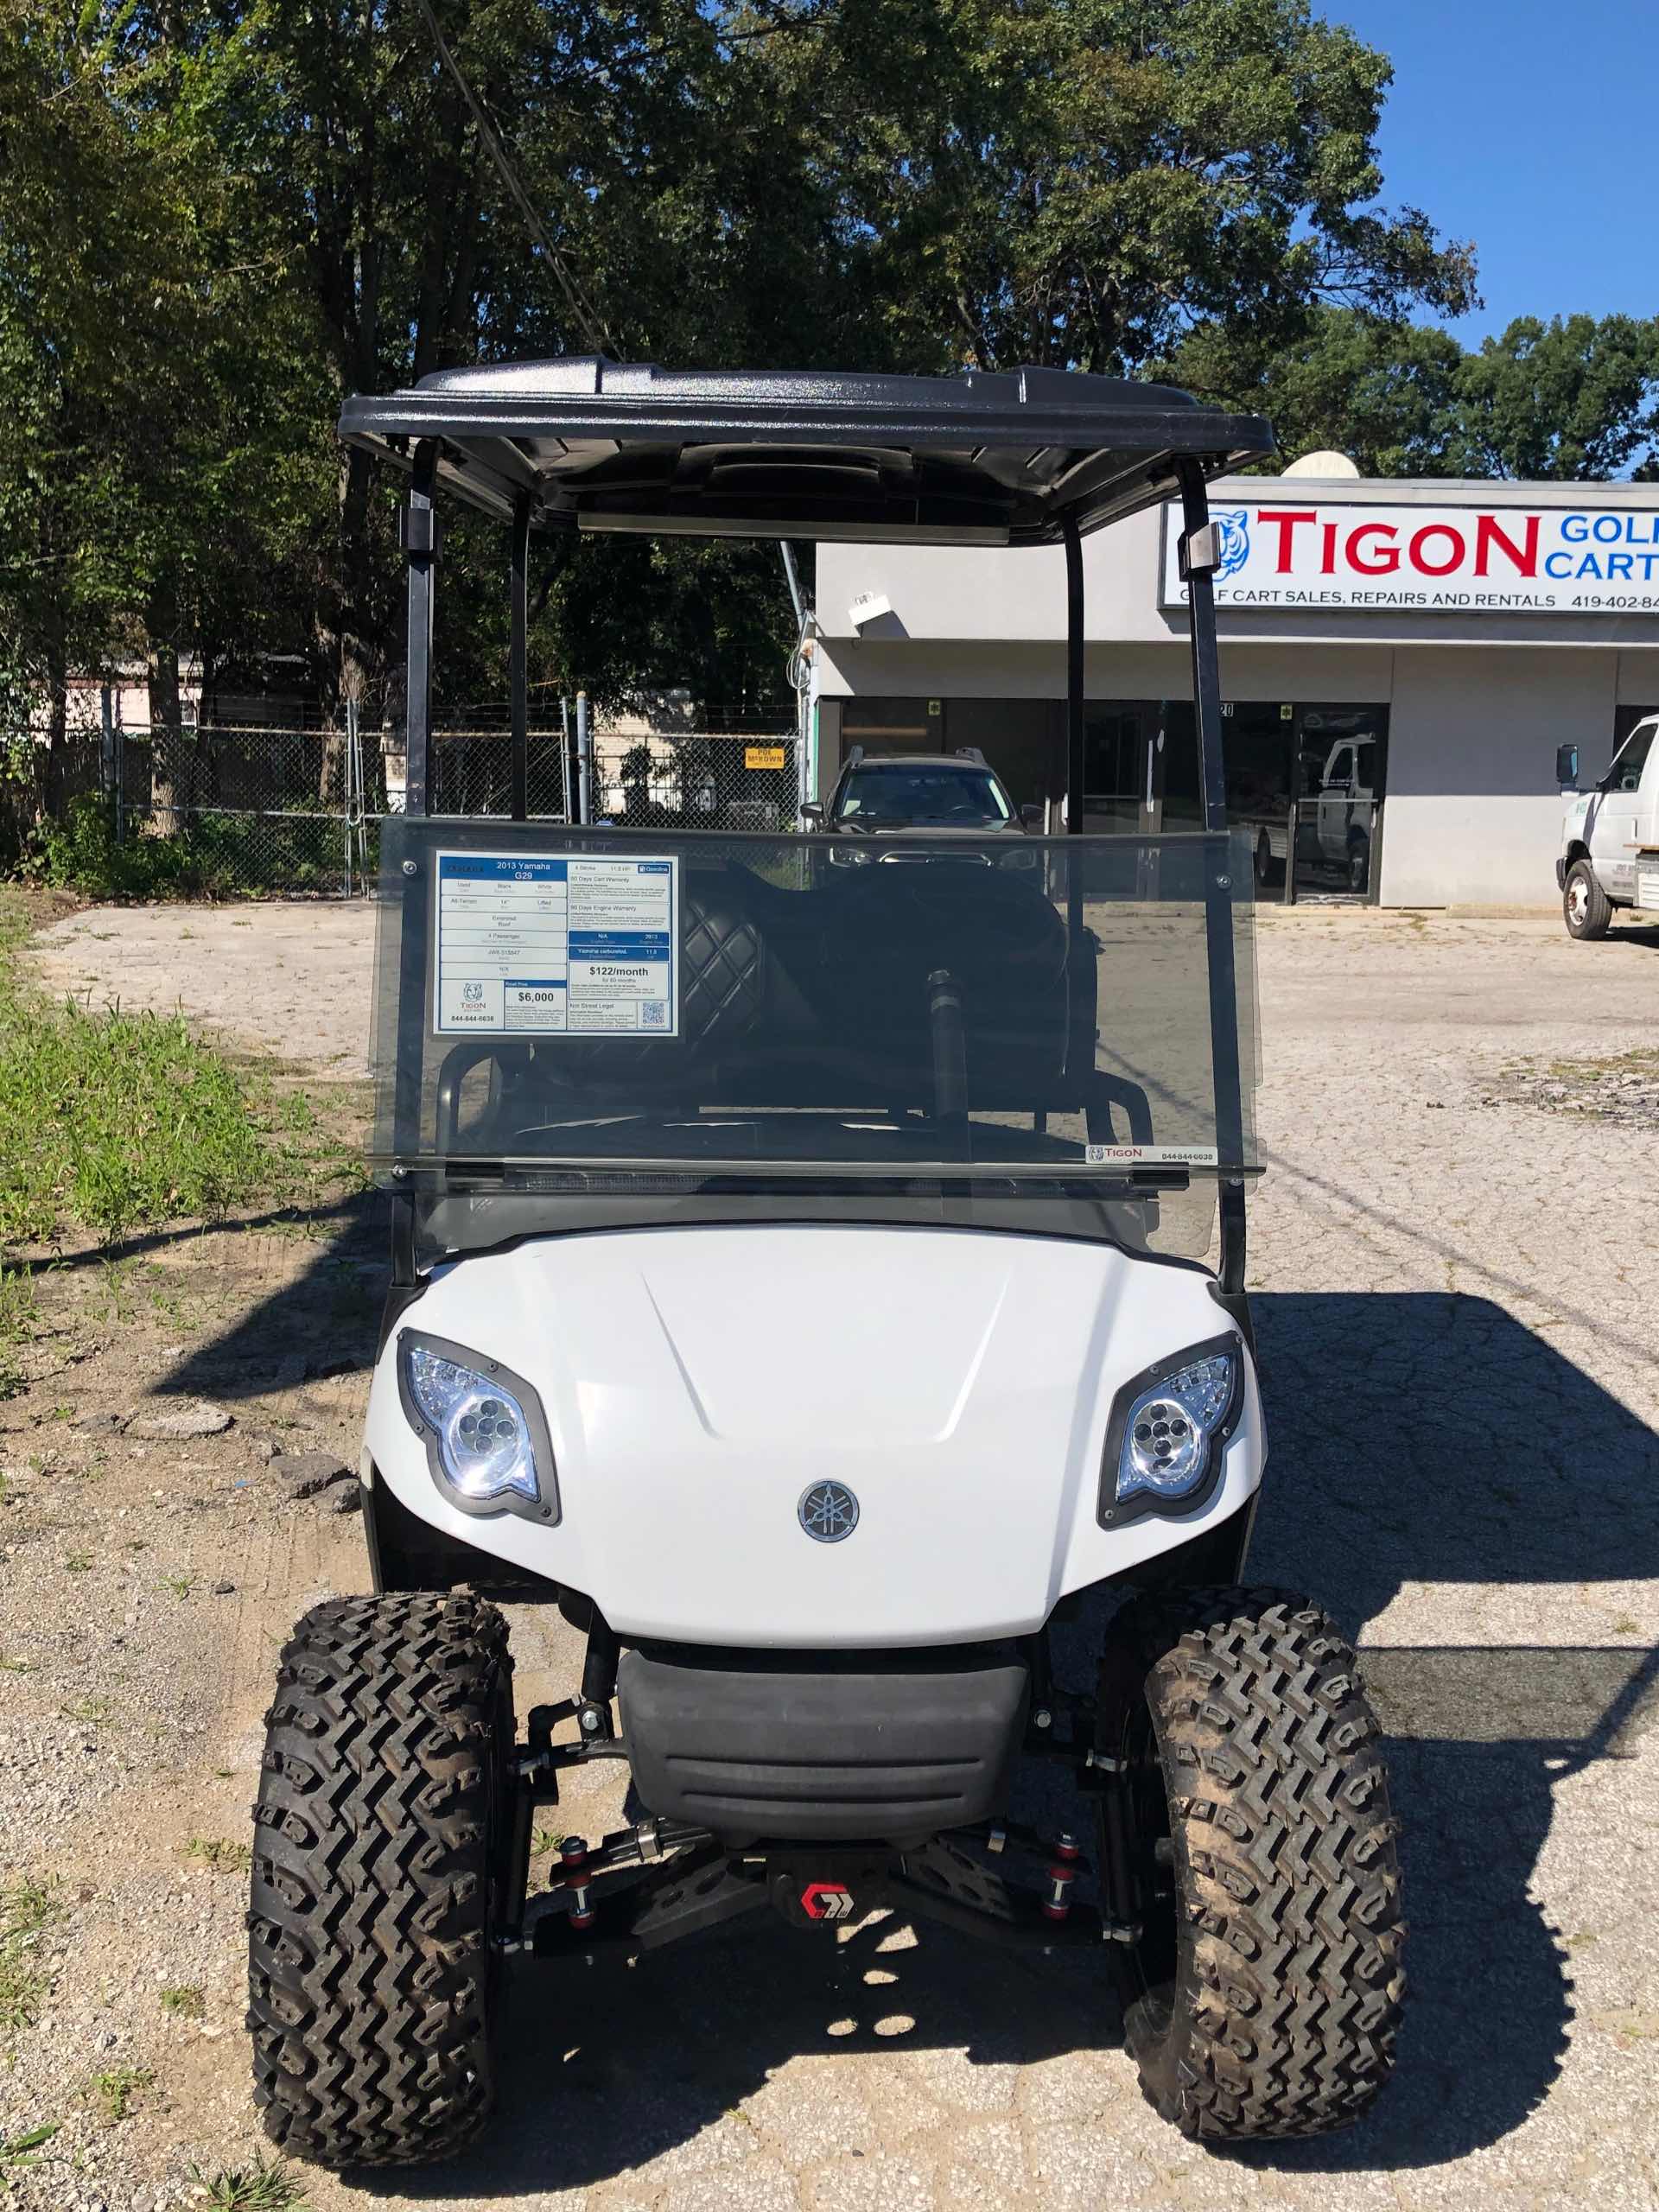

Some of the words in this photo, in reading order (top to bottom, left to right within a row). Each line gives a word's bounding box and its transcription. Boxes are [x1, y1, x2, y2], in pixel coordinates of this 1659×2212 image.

[1560, 515, 1659, 543] GOL
[1257, 509, 1541, 577] TIGON
[1180, 590, 1230, 602] GF
[1233, 590, 1281, 602] CART
[1286, 591, 1346, 604] SALES,
[1351, 592, 1427, 604] REPAIRS
[1432, 594, 1470, 605] AND
[1475, 594, 1555, 607] RENTALS
[497, 861, 517, 870] 2013
[518, 862, 551, 871] Yamaha
[589, 966, 649, 976] $122/month
[518, 992, 554, 1002] $6,000
[1104, 1147, 1143, 1158] TIGON
